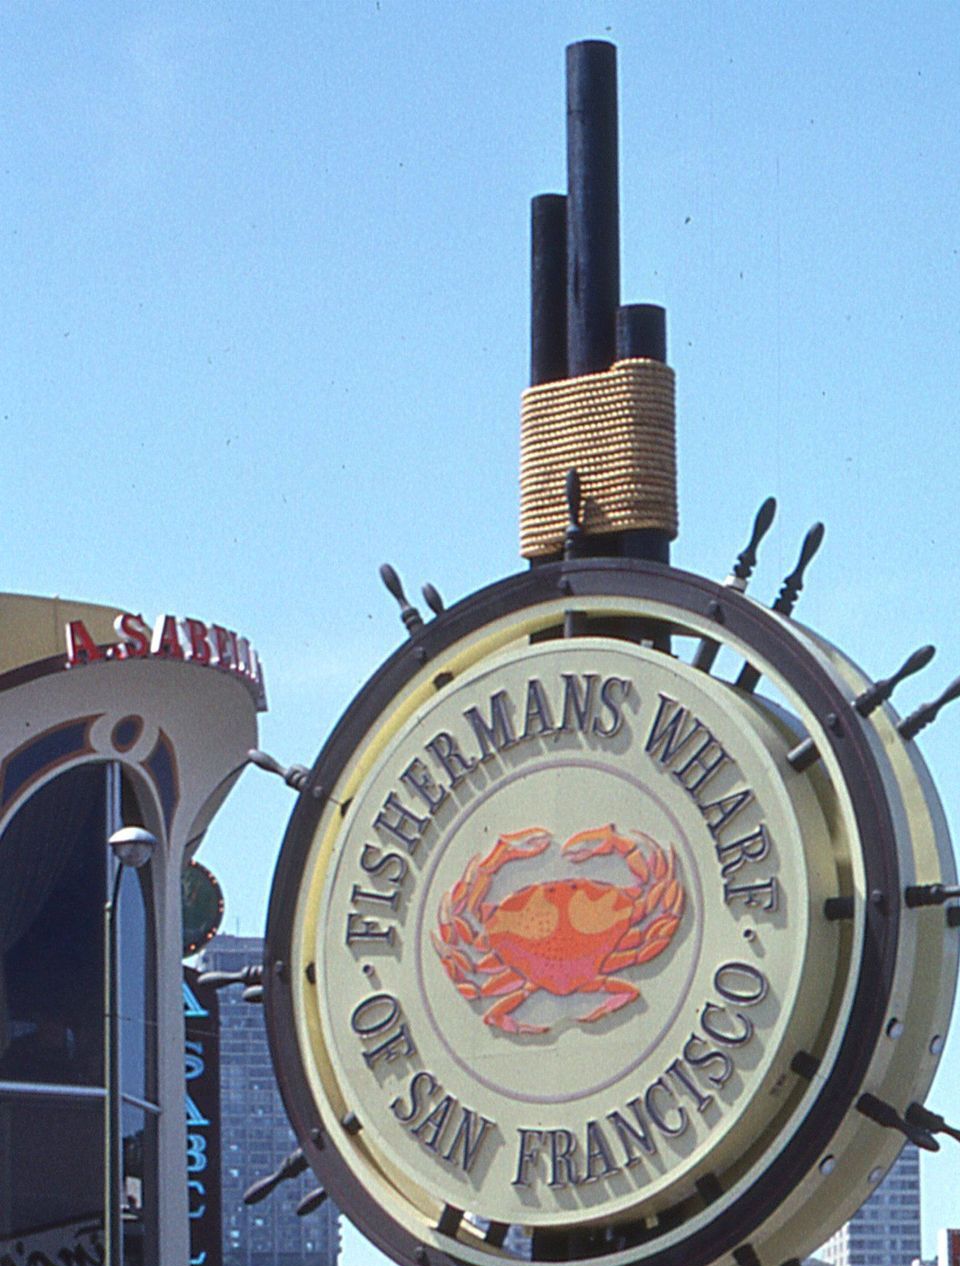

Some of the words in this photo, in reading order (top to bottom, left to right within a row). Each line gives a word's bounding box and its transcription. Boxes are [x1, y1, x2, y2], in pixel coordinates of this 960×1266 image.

[346, 673, 632, 946] FISHERMANS
[645, 692, 779, 914] WHARF
[351, 994, 414, 1070] OF
[390, 1071, 496, 1173] SAN
[511, 961, 768, 1189] FRANCISCO
